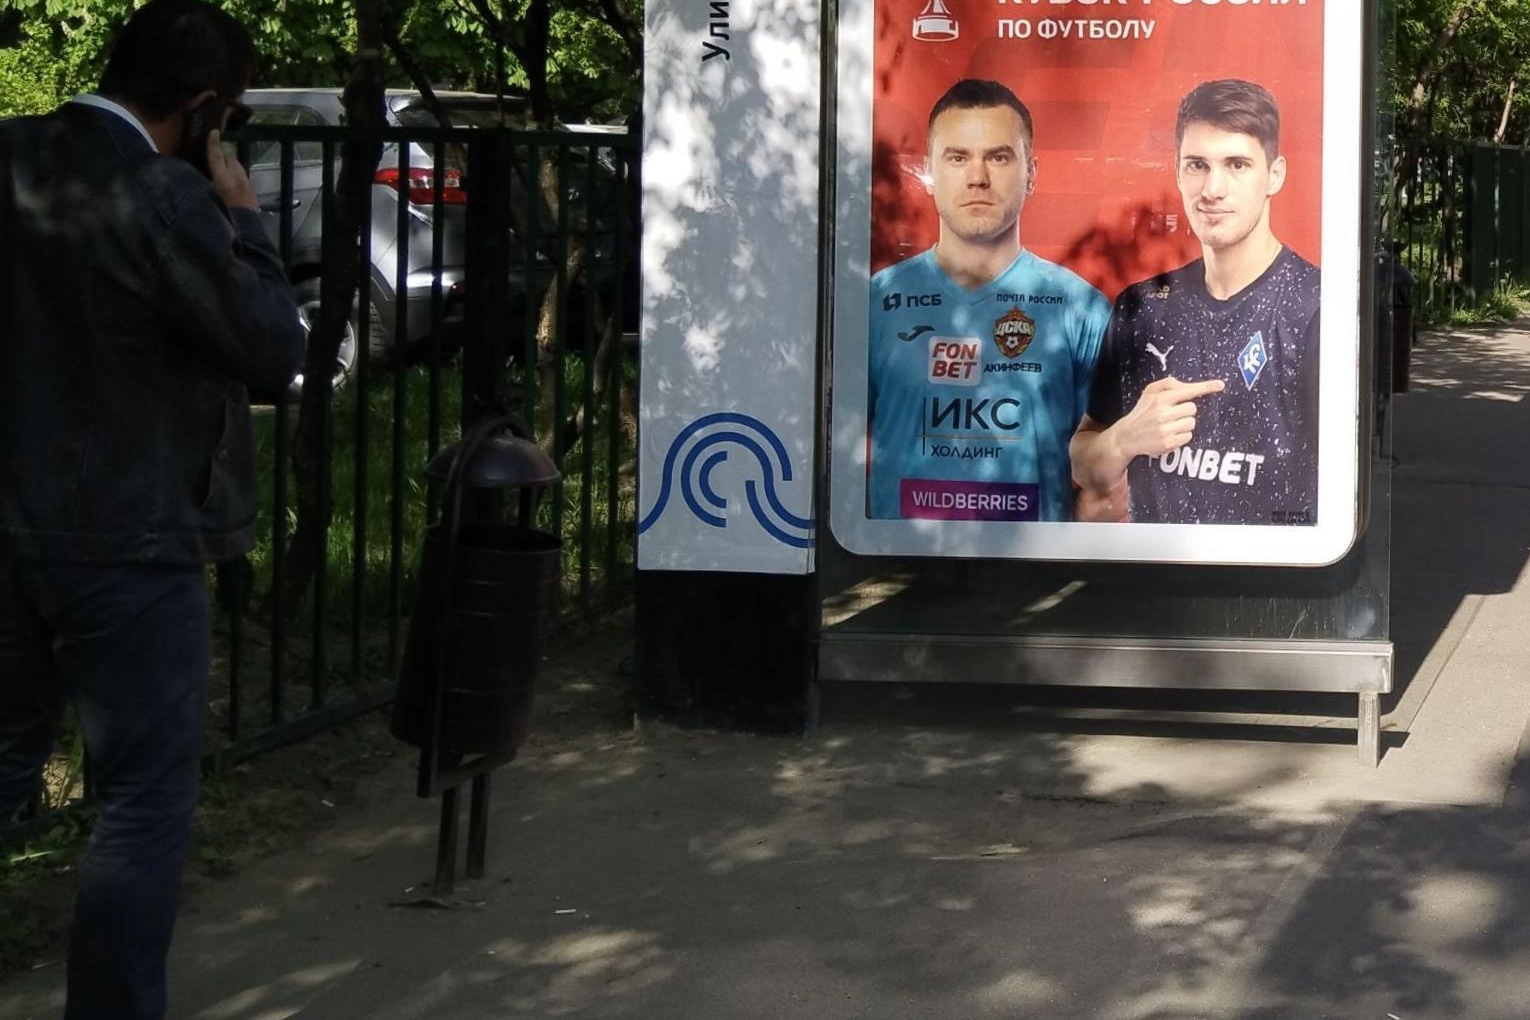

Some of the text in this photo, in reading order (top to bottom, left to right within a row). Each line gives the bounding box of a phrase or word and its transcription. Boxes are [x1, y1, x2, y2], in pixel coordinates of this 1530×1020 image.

[998, 18, 1156, 40] ПО ФУТБОЛУ
[906, 294, 942, 308] ПСБ
[1029, 294, 1064, 305] РОССИИ
[995, 320, 1033, 337] ЦСКА
[932, 342, 977, 360] FON
[932, 360, 977, 379] BET
[931, 396, 1021, 431] ИКС
[931, 444, 1003, 460] ХОЛДИНГ
[912, 490, 1028, 511] WILDBERRIES
